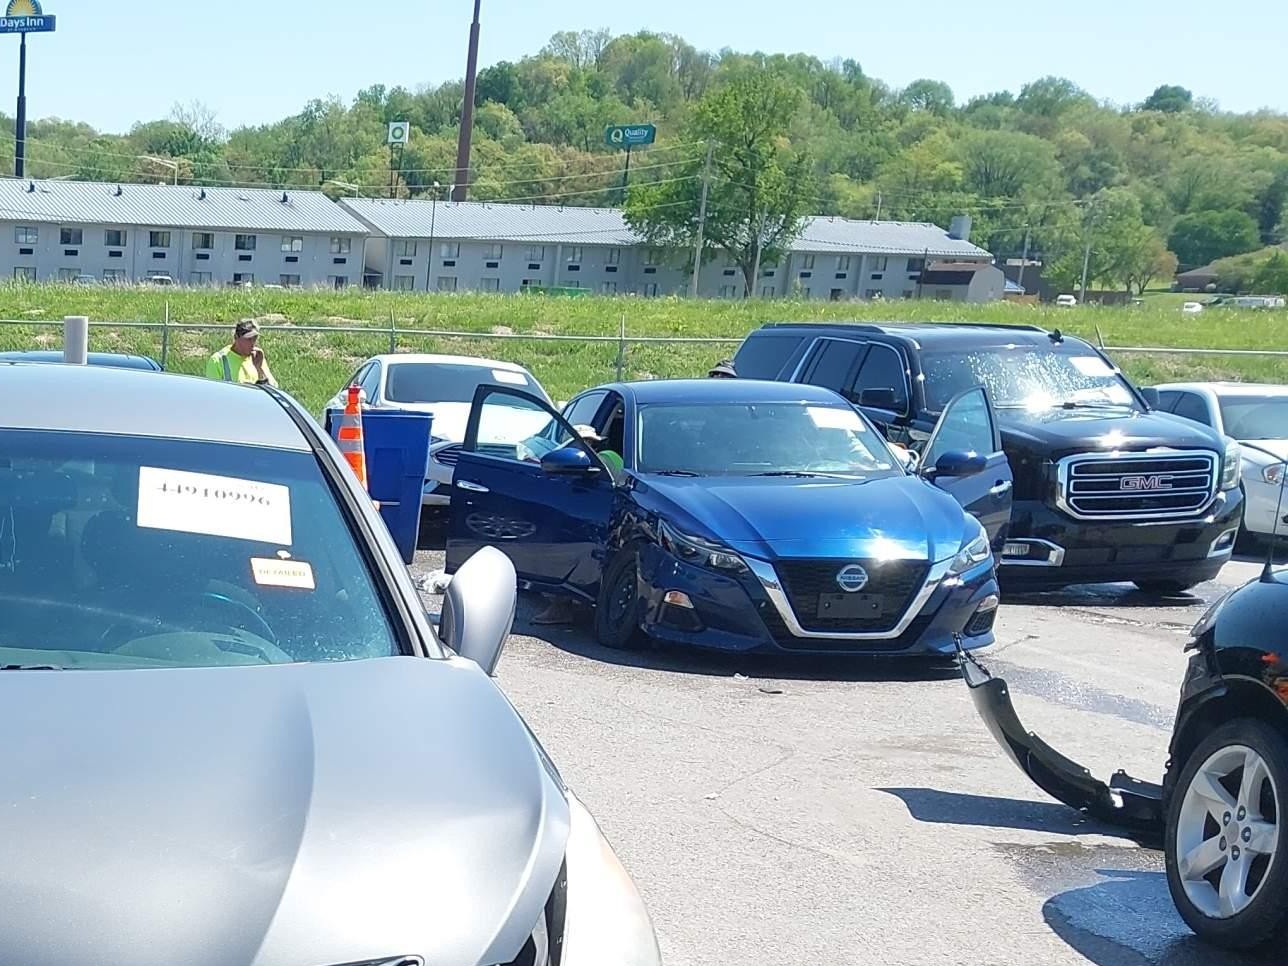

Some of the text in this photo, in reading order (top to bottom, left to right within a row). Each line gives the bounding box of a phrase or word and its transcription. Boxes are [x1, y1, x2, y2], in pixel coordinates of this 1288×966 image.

[0, 16, 44, 28] Days Inn
[624, 128, 648, 137] Quality
[1119, 474, 1174, 490] GMC
